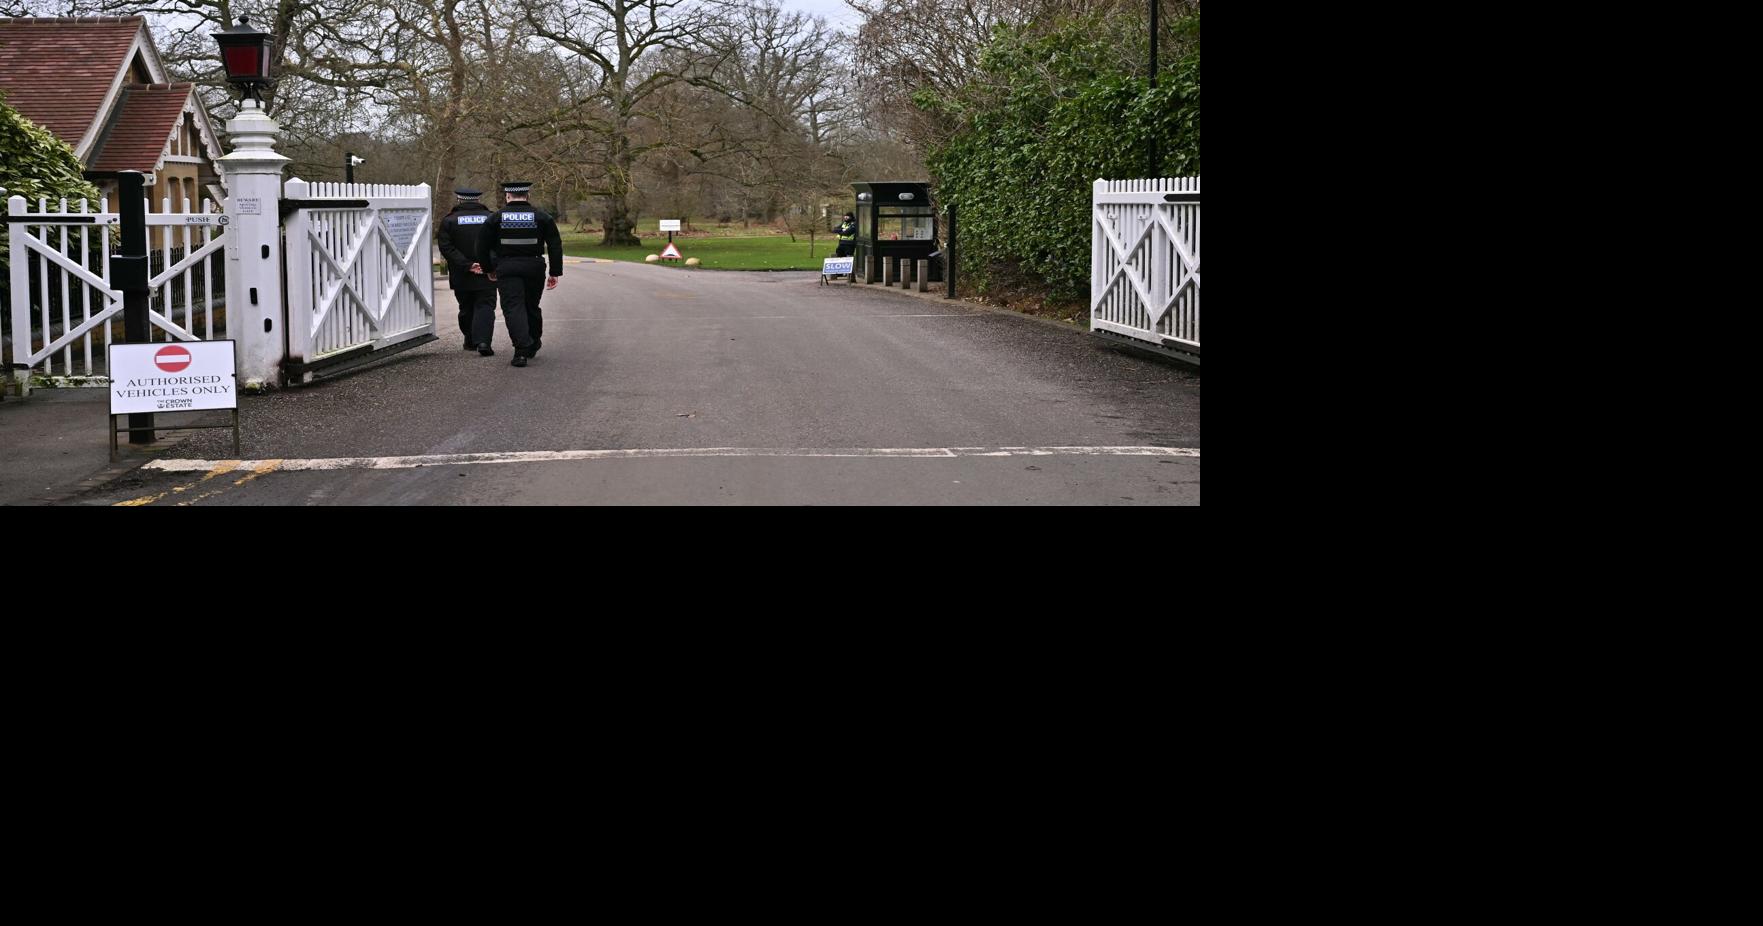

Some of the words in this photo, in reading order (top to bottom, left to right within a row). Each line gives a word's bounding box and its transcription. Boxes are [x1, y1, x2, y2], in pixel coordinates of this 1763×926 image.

[126, 376, 220, 388] AUTHORISED
[116, 387, 188, 398] VEHICLES
[192, 386, 230, 394] ONLY
